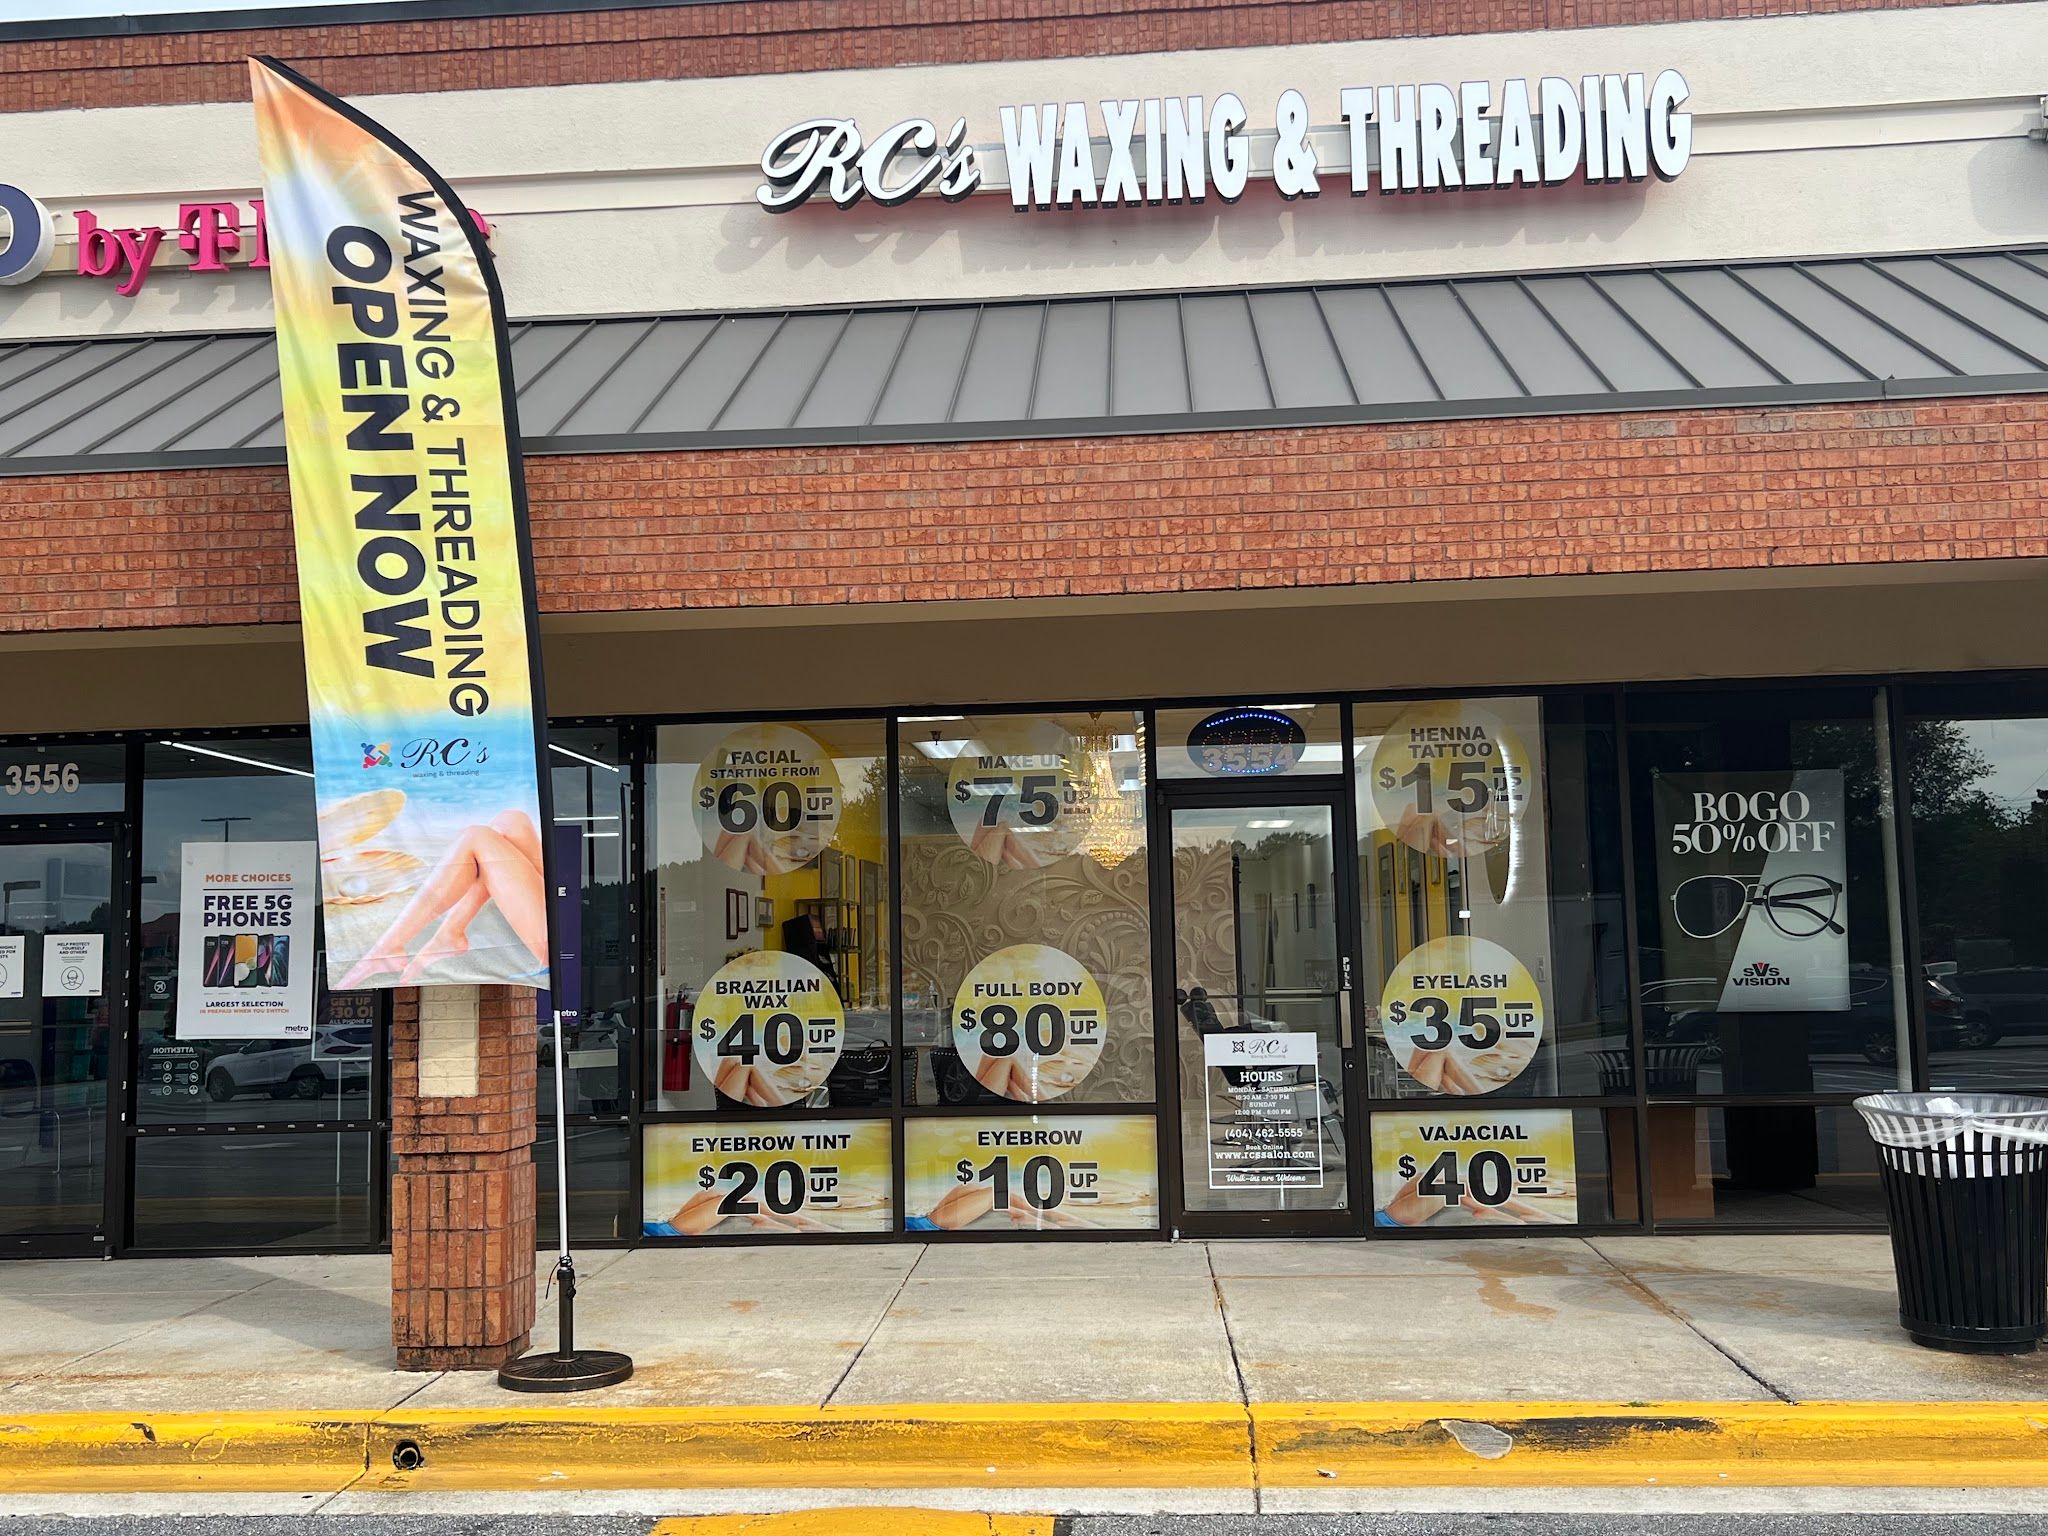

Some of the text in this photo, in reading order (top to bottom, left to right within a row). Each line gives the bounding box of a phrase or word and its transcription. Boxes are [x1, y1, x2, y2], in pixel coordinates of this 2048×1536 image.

[756, 68, 1692, 212] RC's WAXING & THREADING
[73, 209, 167, 297] by
[327, 226, 435, 679] OPEN NOW
[398, 191, 489, 717] WAXING & THREADING
[1411, 726, 1487, 742] HENNA
[732, 750, 802, 765] FACIAL
[1408, 742, 1493, 759] TATTOO
[978, 755, 1033, 769] MAKE
[1202, 748, 1297, 773] 3554
[5, 762, 80, 796] 3556
[710, 766, 820, 779] STARTING FROM
[1379, 761, 1489, 814] $15
[699, 781, 834, 834] $60 UP
[955, 775, 1059, 827] $75
[1692, 790, 1810, 823] BOGO
[205, 873, 292, 883] MORE CHOICES
[204, 895, 292, 911] FREE 5G
[203, 911, 292, 927] PHONES
[1342, 957, 1352, 987] PULL
[716, 979, 820, 994] BRAZILIAN
[1413, 974, 1507, 989] EYELASH
[1732, 977, 1790, 986] VISION
[974, 982, 1083, 998] FULL BODY
[744, 995, 788, 1009] WAX
[285, 1025, 309, 1033] metro
[960, 1003, 1098, 1058] $80 UP
[1389, 997, 1534, 1050] $35 UP
[699, 1013, 836, 1066] $40 UP
[1240, 1071, 1283, 1083] HOURS
[978, 1130, 1082, 1146] EYEBROW
[1225, 1128, 1303, 1140] (404) 462-5555
[1419, 1125, 1528, 1141] VAJACIAL
[692, 1134, 851, 1152] EYEBROW TINT
[1214, 1150, 1315, 1160] www.rcssalon.com
[956, 1155, 1098, 1210] $10 UP
[1275, 1174, 1306, 1182] Welcome
[1399, 1150, 1546, 1206] $40 UP
[698, 1161, 838, 1215] $20 UP
